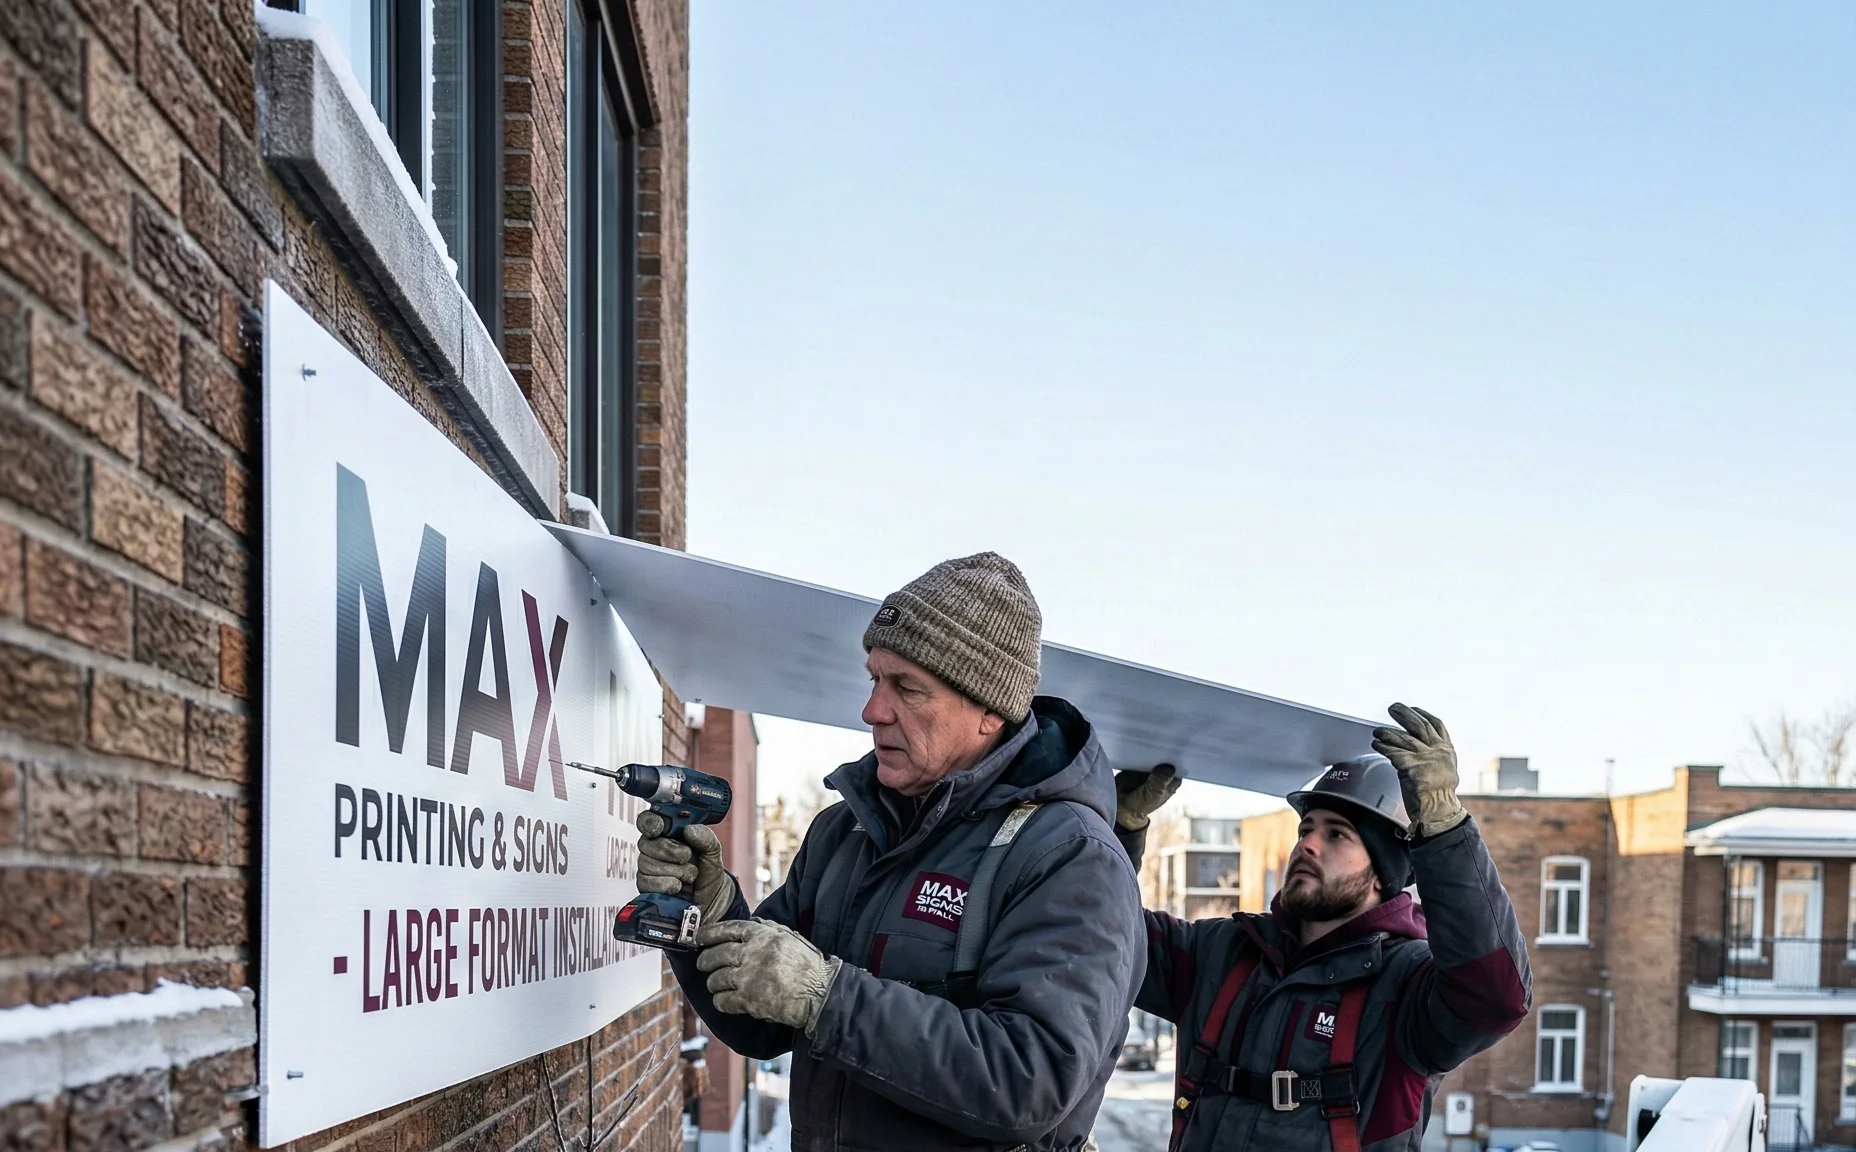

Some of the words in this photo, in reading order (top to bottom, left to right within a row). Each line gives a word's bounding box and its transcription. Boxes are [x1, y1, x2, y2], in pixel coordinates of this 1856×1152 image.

[335, 461, 569, 802] MAX
[334, 782, 485, 870] PRINTING
[491, 811, 507, 871] &
[513, 815, 569, 876] SIGNS
[920, 880, 968, 906] MAX
[362, 907, 459, 1013] LARGE
[468, 907, 549, 994] FORMAT
